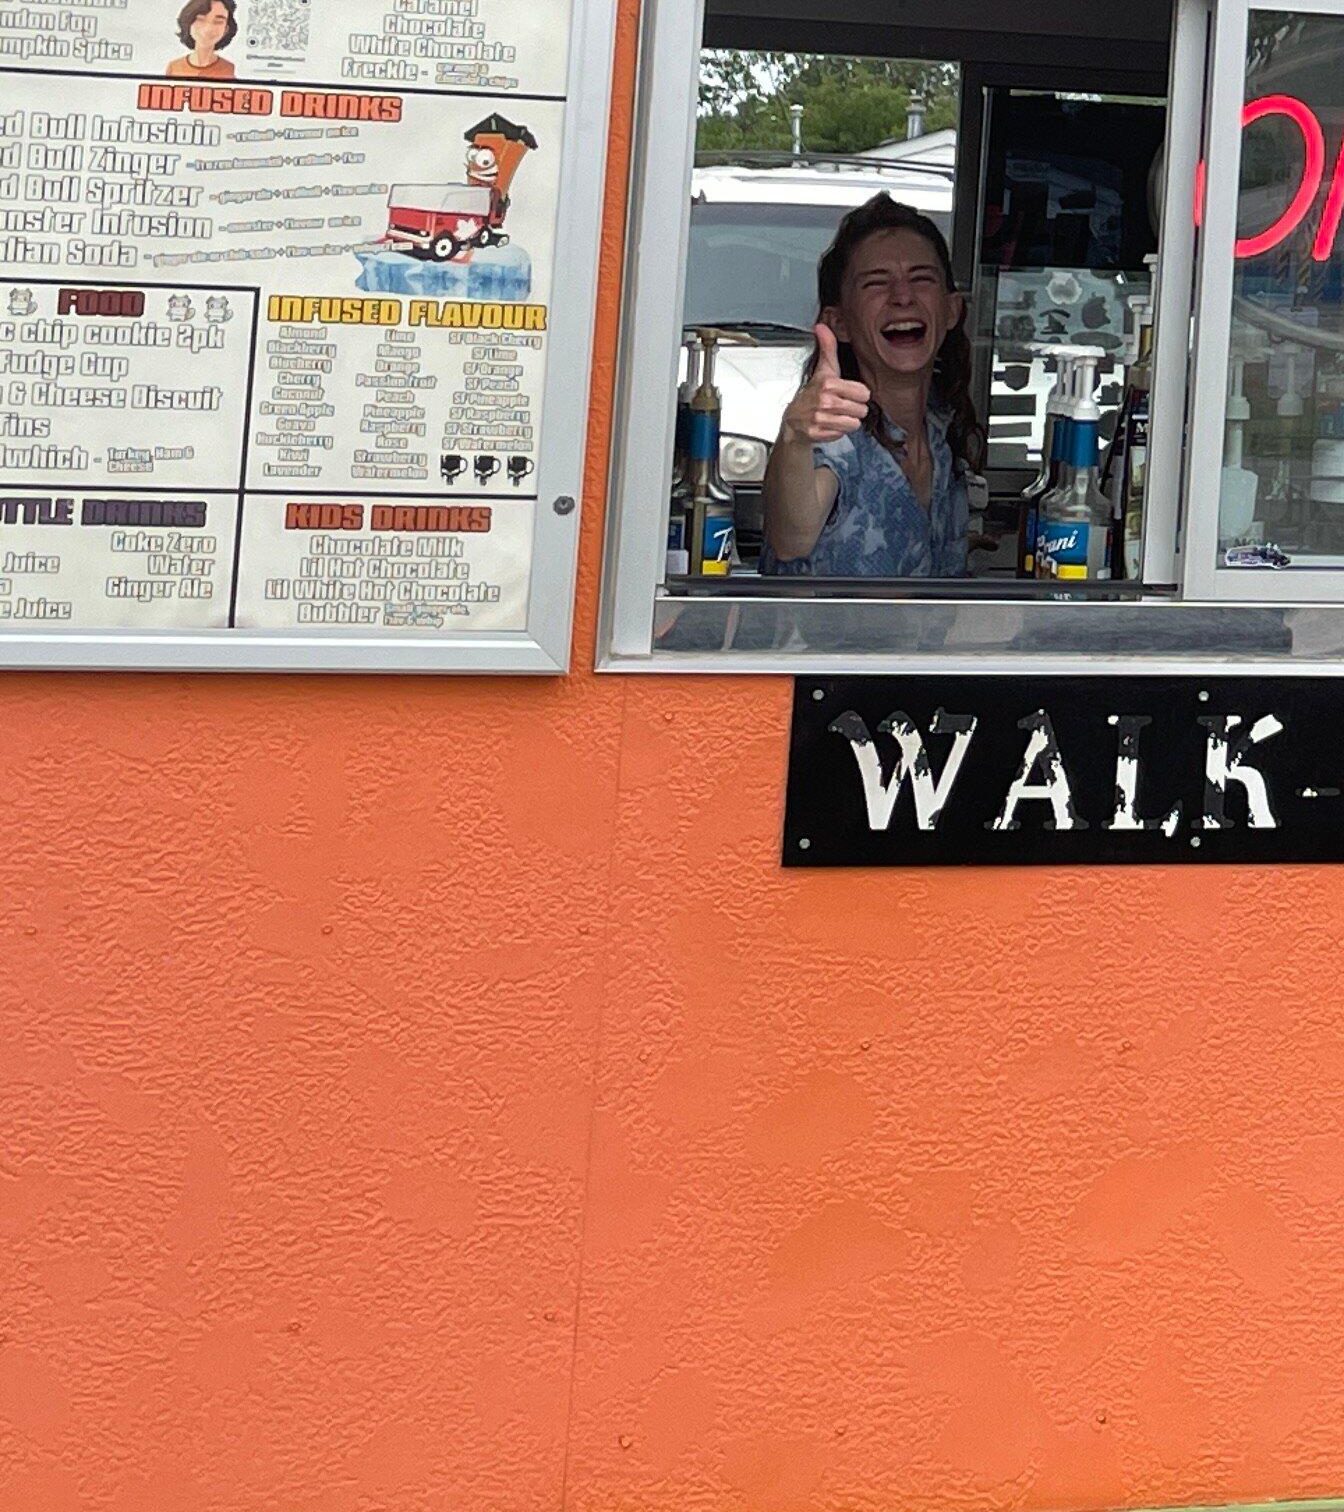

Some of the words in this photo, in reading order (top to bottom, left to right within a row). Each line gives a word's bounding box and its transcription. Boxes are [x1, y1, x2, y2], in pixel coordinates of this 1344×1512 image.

[0, 9, 55, 30] ndon
[59, 9, 98, 38] Fog
[384, 14, 486, 39] Chocolate
[0, 34, 68, 59] mpkin
[72, 38, 132, 62] Spice
[350, 34, 411, 57] White
[414, 38, 516, 63] Chocolate
[342, 57, 418, 81] Freckle
[137, 84, 273, 116] INFUSED
[280, 91, 403, 123] DRINKS
[30, 112, 86, 139] Bull
[27, 144, 84, 171] Bull
[88, 145, 181, 180] Zinger
[25, 175, 80, 202] Bull
[86, 177, 204, 209] Spritzer
[0, 206, 86, 234] nster
[91, 209, 212, 238] Infusion
[67, 238, 138, 267] Soda
[58, 288, 145, 317] FOOD
[268, 295, 401, 325] INFUSED
[409, 300, 547, 330] FLAVOUR
[21, 319, 78, 349] chip
[84, 321, 171, 347] cookie
[176, 324, 224, 354] 2pk
[80, 352, 129, 382] Cup
[31, 382, 126, 408] Cheese
[131, 384, 223, 410] Biscuit
[0, 497, 75, 525] TTLE
[81, 498, 207, 528] DRINKS
[285, 502, 364, 530] KIDS
[370, 503, 493, 533] DRINKS
[111, 530, 163, 553] Coke
[167, 532, 217, 554] Zero
[309, 534, 414, 558] Chocolate
[416, 537, 464, 558] Milk
[3, 551, 60, 574] Juice
[148, 554, 215, 576] Water
[300, 557, 326, 579] Lil
[328, 557, 365, 579] Hot
[367, 558, 470, 580] Chocolate
[106, 576, 177, 602] Ginger
[178, 578, 213, 599] Ale
[264, 579, 290, 601] Lil
[293, 579, 356, 601] White
[359, 580, 396, 601] Hot
[397, 581, 501, 603] Chocolate
[14, 598, 72, 620] Juice
[298, 602, 380, 624] Bubbler
